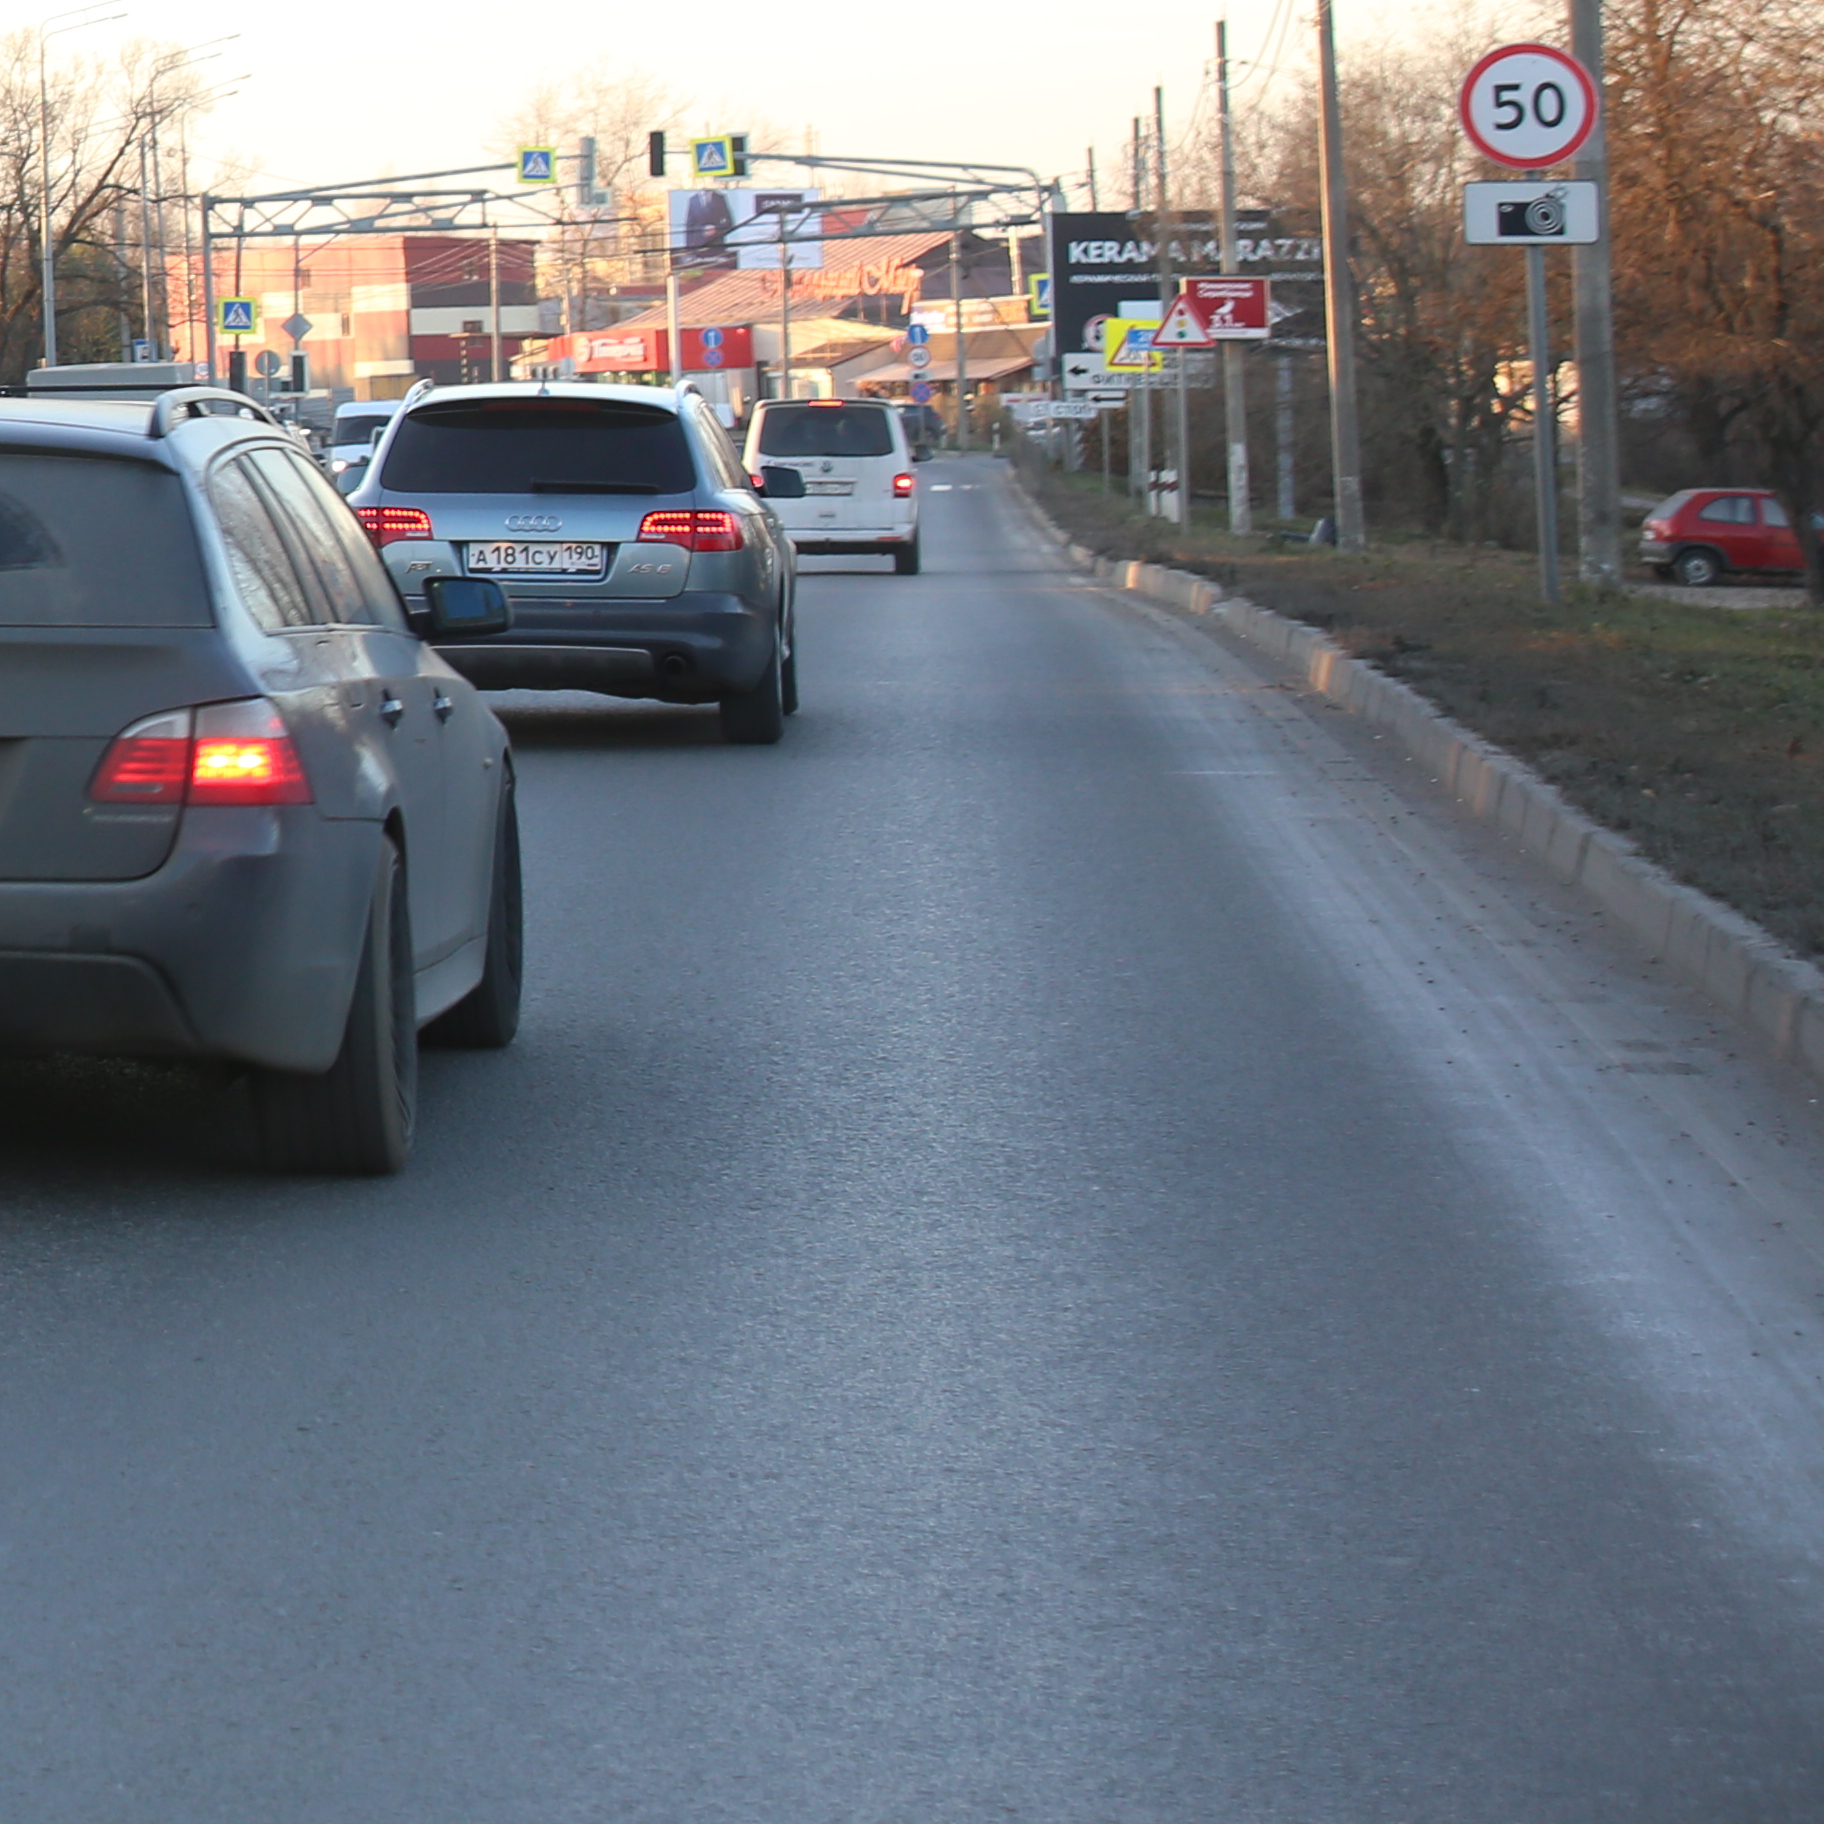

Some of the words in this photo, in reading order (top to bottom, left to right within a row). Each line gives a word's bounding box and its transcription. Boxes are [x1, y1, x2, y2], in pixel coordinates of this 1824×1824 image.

[1493, 81, 1566, 131] 50
[1068, 239, 1186, 264] KERAMA
[564, 545, 593, 561] 190
